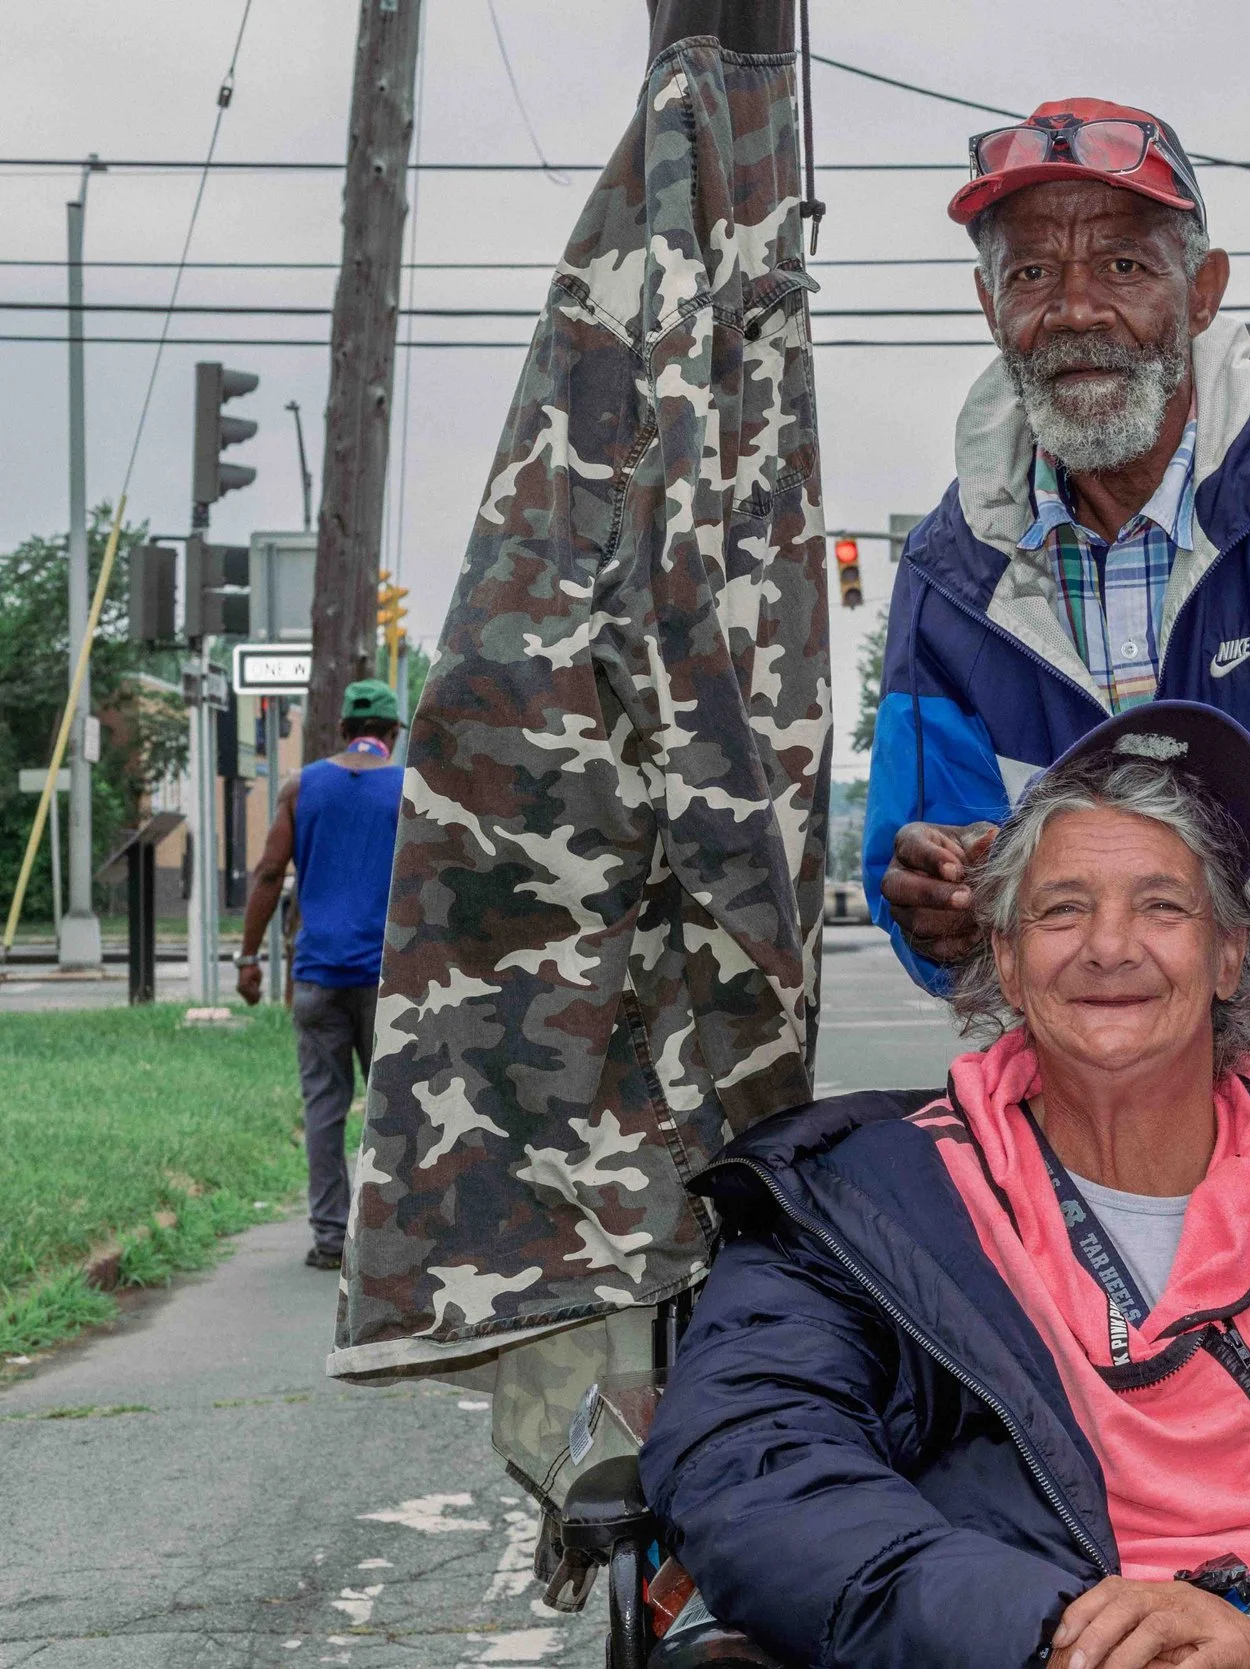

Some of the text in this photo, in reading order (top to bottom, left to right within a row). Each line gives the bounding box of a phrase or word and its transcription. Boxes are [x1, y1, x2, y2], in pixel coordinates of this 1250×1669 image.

[1216, 636, 1250, 662] NIKE
[1080, 1232, 1110, 1269] TAR
[1098, 1265, 1142, 1321] HEELS
[1110, 1313, 1128, 1350] PINK
